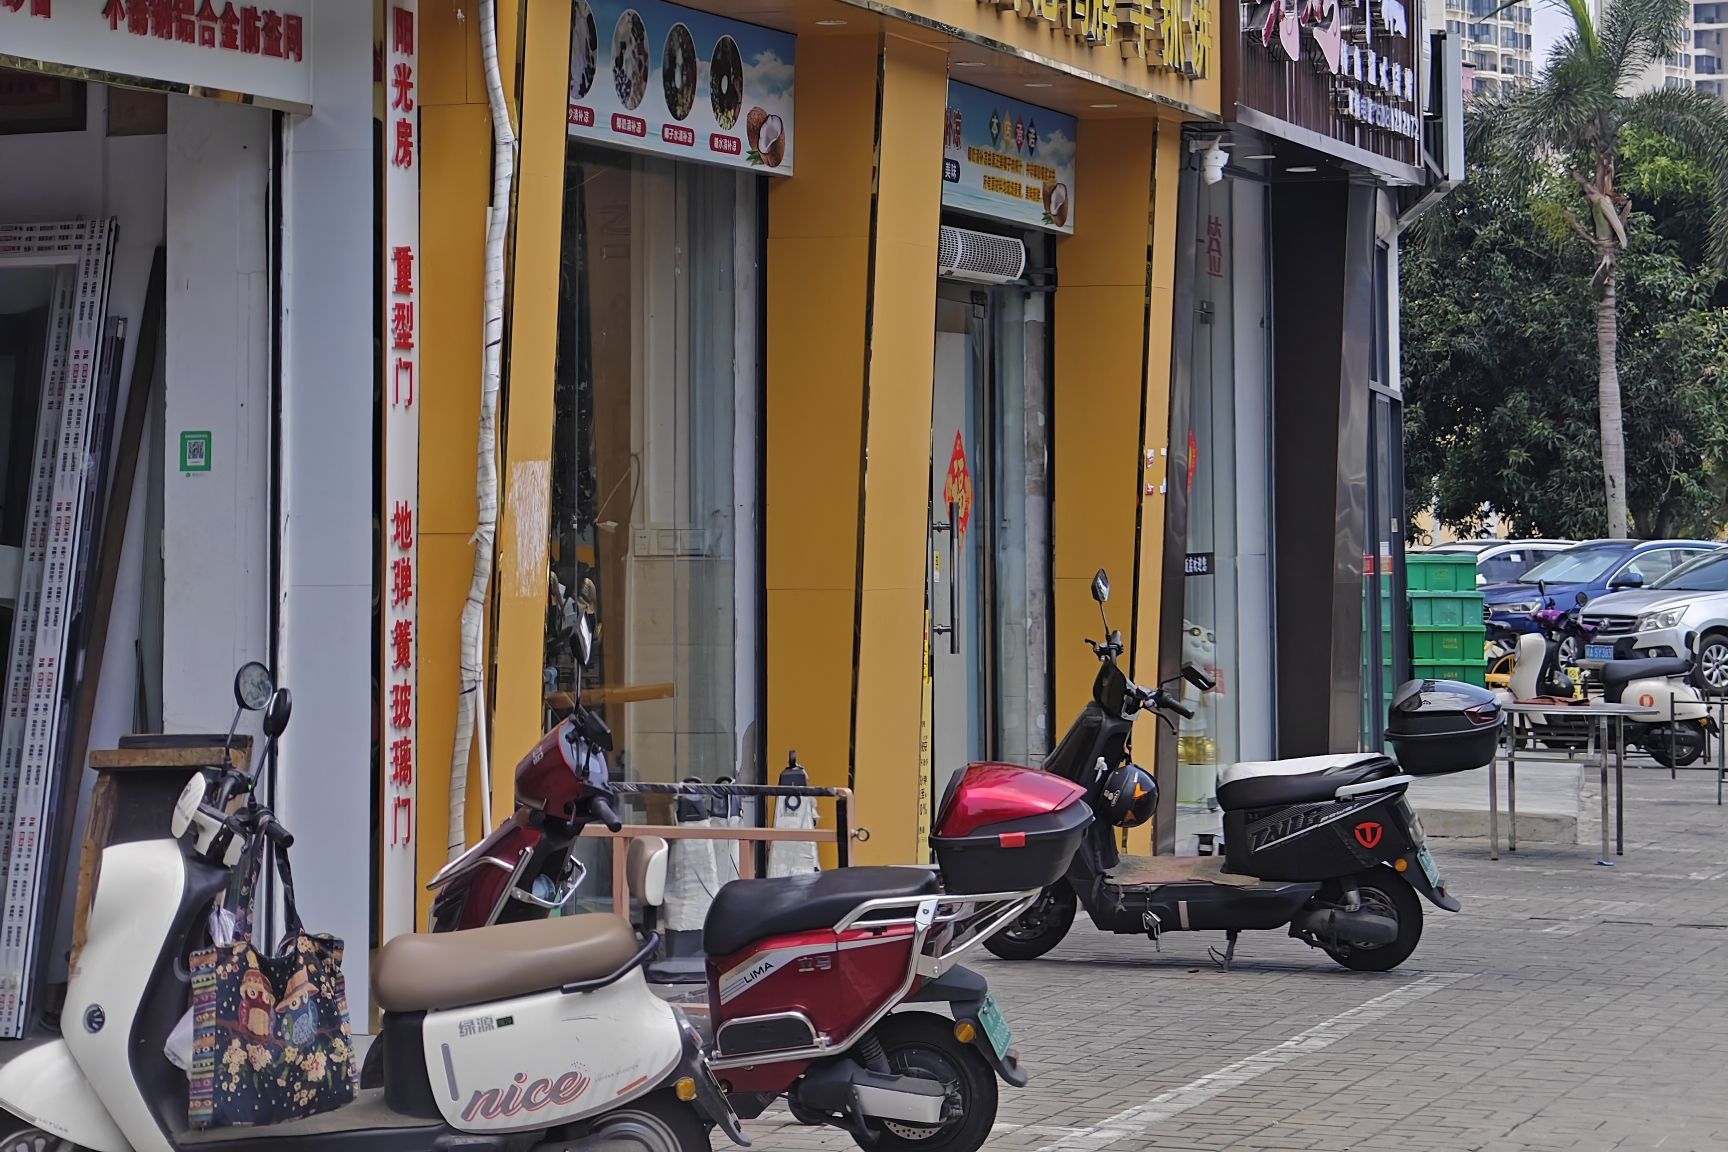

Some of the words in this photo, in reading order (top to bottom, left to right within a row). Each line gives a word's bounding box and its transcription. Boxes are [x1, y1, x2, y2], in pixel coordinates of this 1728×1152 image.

[391, 6, 414, 169] 阳光房
[391, 245, 415, 408] 重型门
[390, 500, 414, 848] 地弹簧玻璃门
[458, 1016, 495, 1038] 绿源
[744, 962, 774, 984] LIMA
[461, 1067, 591, 1123] nice
